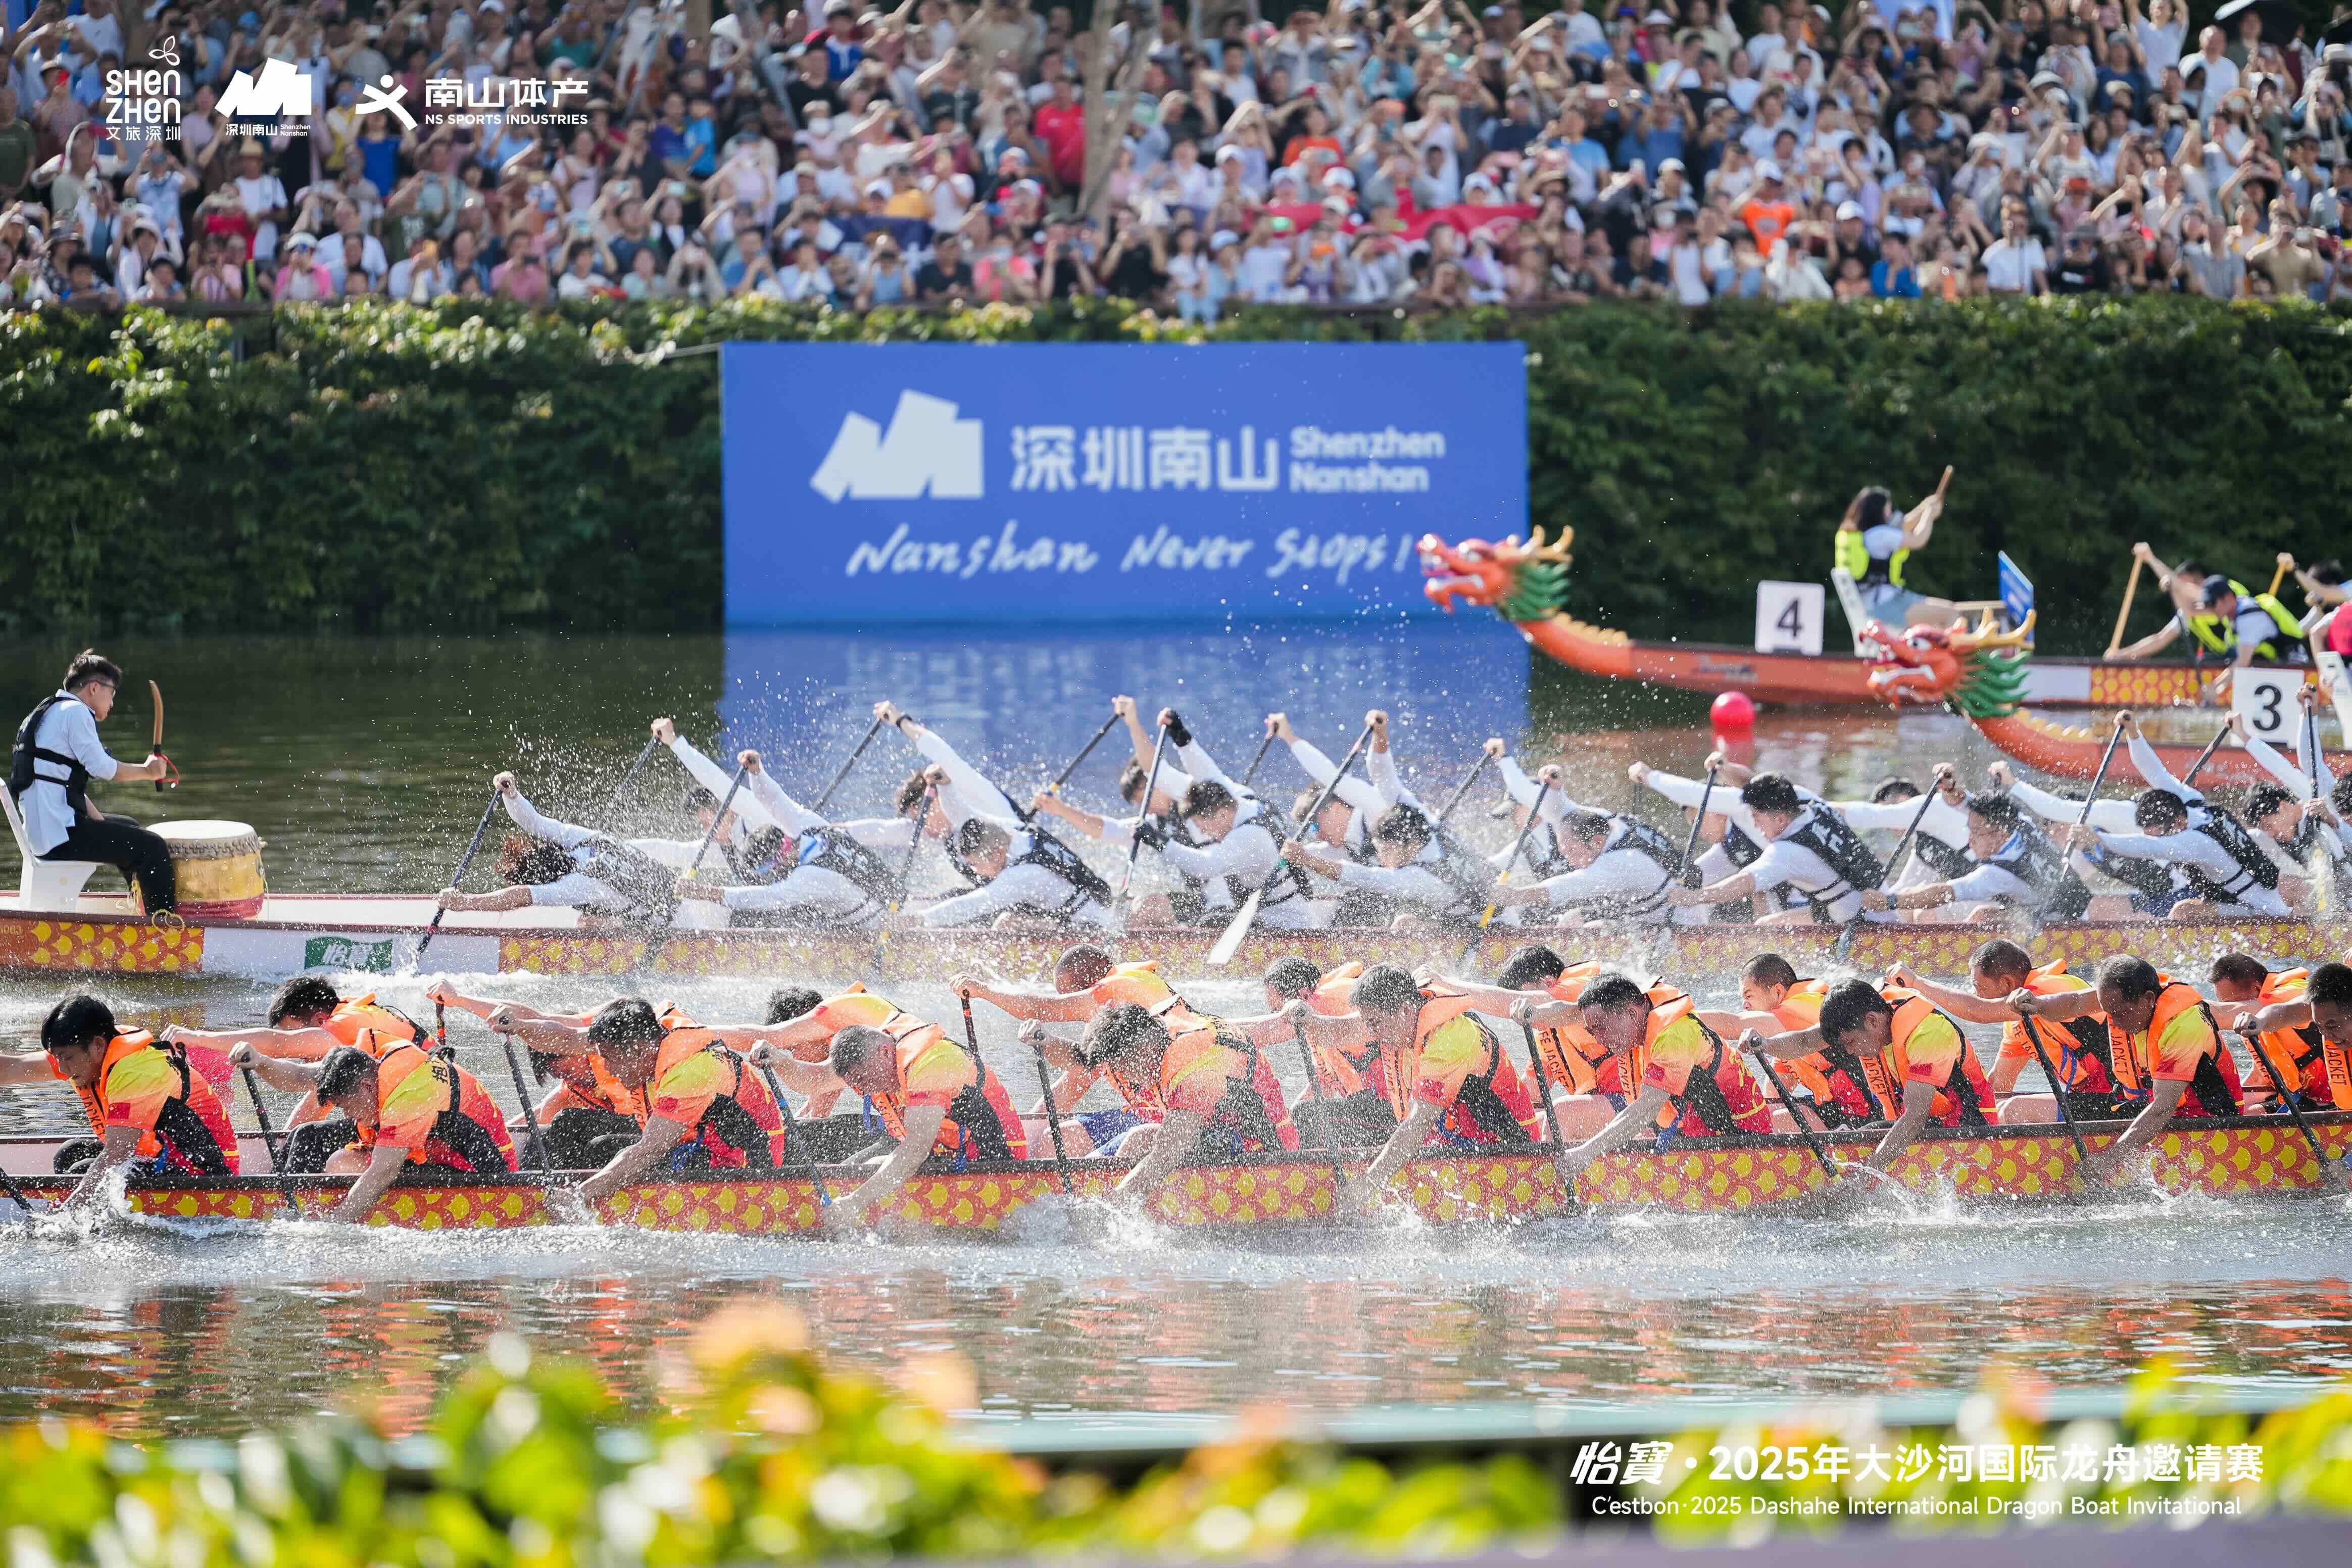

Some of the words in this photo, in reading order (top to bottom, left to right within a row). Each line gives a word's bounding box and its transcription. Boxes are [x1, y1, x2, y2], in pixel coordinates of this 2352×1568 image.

[1011, 425, 1280, 492] 深圳南山
[1289, 425, 1447, 459] Shenzhen
[1289, 460, 1430, 493] Nanshan
[845, 518, 1100, 580] Nanshan
[1119, 524, 1256, 573] Never
[1776, 598, 1802, 638] 4
[2252, 684, 2282, 731] 3
[2111, 1033, 2129, 1075] JACKET
[2325, 1043, 2347, 1086] JACKET
